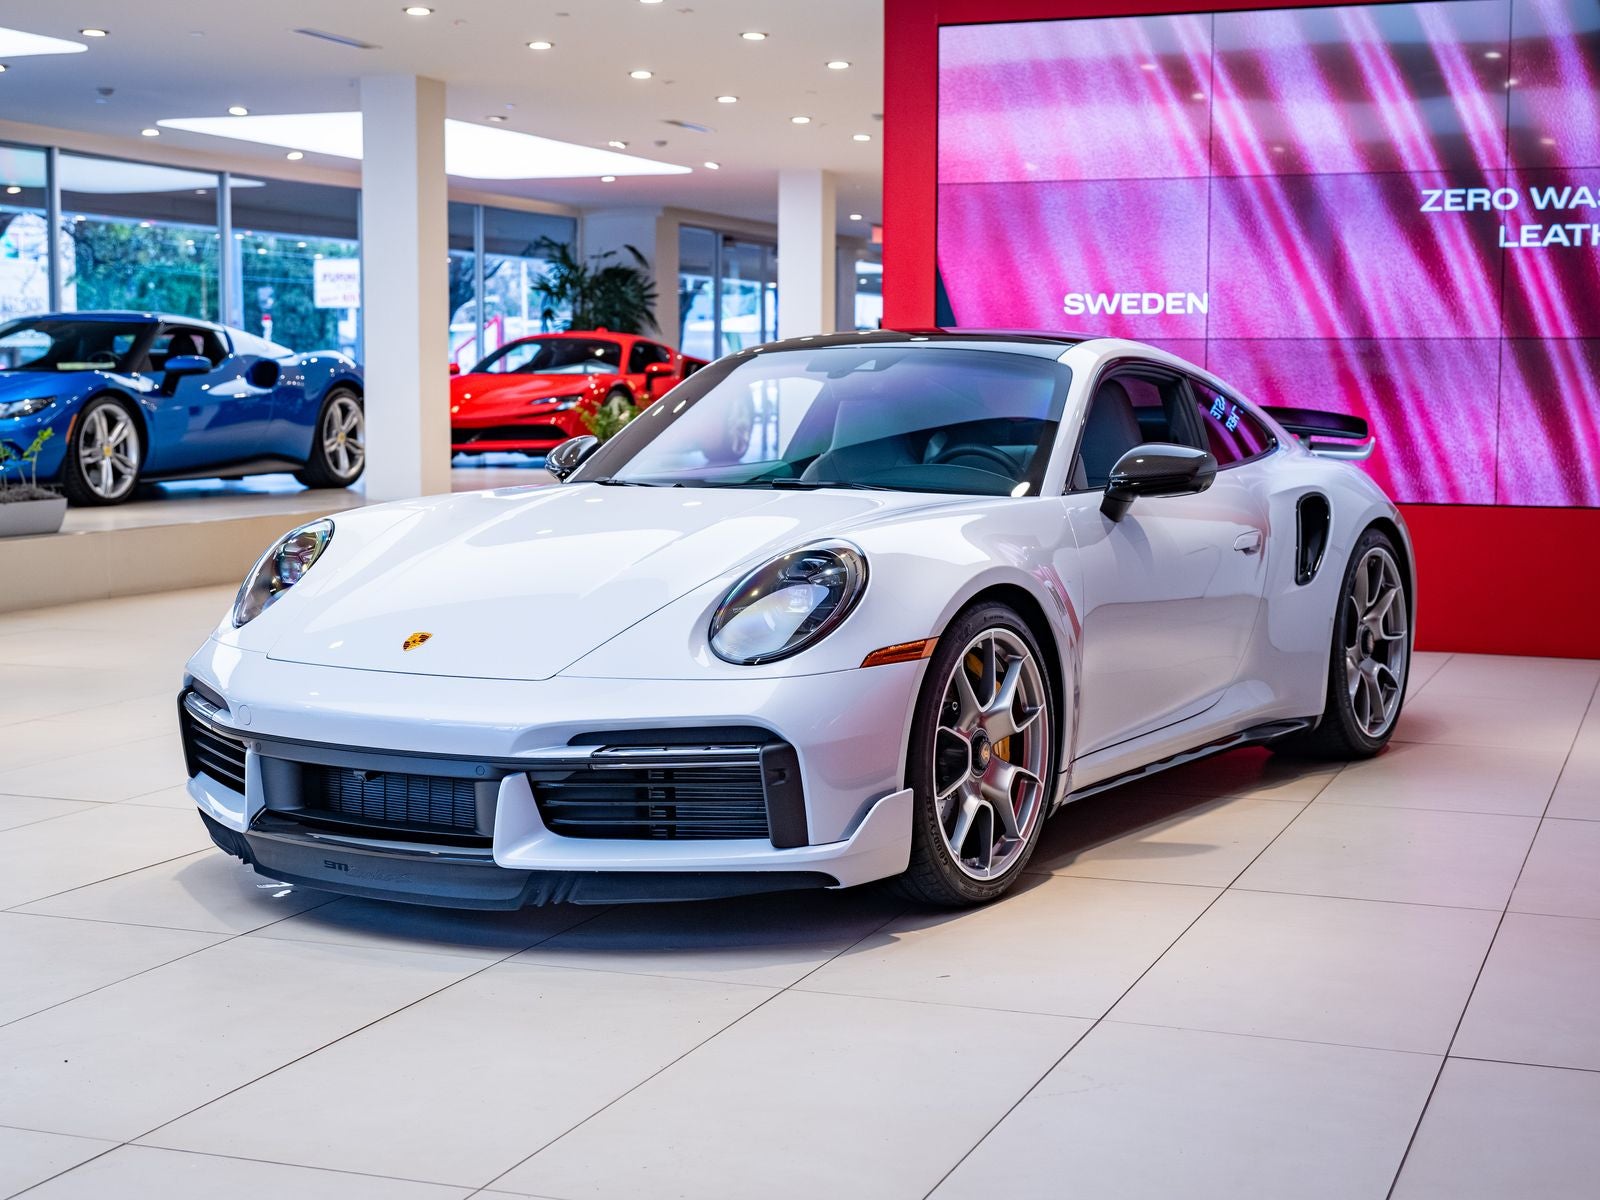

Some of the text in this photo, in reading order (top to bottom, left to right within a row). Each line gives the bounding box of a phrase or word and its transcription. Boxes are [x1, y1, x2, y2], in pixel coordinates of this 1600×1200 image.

[1420, 186, 1600, 211] ZERO WA
[1063, 292, 1208, 315] SWEDEN
[323, 859, 349, 872] 911
